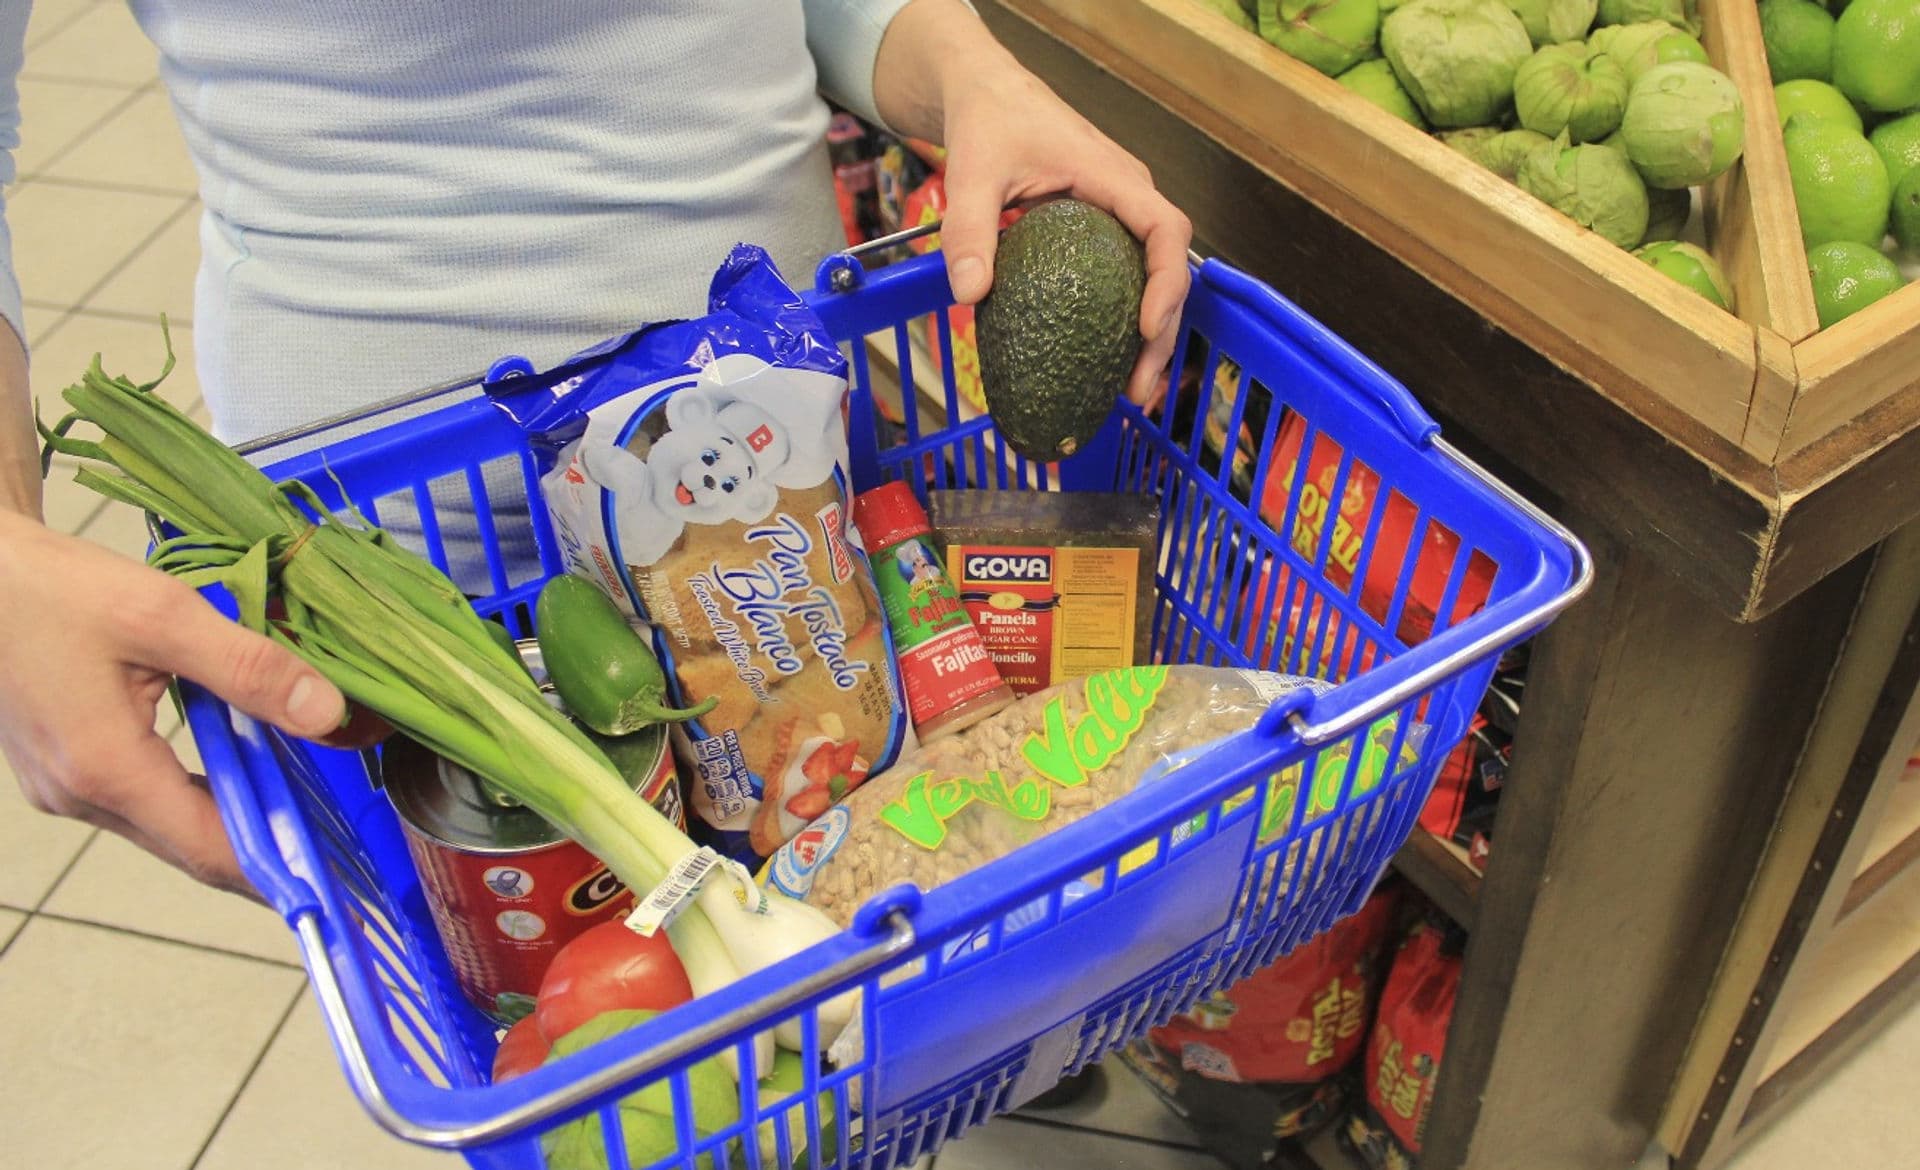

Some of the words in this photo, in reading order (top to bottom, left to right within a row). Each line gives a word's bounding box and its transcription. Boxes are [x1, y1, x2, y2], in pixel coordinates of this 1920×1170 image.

[746, 424, 774, 454] B
[1282, 460, 1363, 575] OYAL
[967, 557, 1047, 579] GOYA
[713, 561, 800, 672] Blanco
[748, 516, 810, 592] Pan
[788, 590, 868, 688] Tostado
[687, 573, 733, 627] Toasted
[715, 628, 750, 669] White
[979, 611, 1037, 625] Panela
[989, 626, 1025, 634] BROWN
[982, 635, 1010, 644] UGAR
[1011, 635, 1039, 644] CANE
[931, 644, 988, 677] Fajitas
[988, 650, 1037, 663] loncillo
[1004, 676, 1039, 685] ATURAL
[1020, 664, 1173, 788] Valle
[706, 738, 723, 756] 120
[879, 770, 1051, 850] Verde
